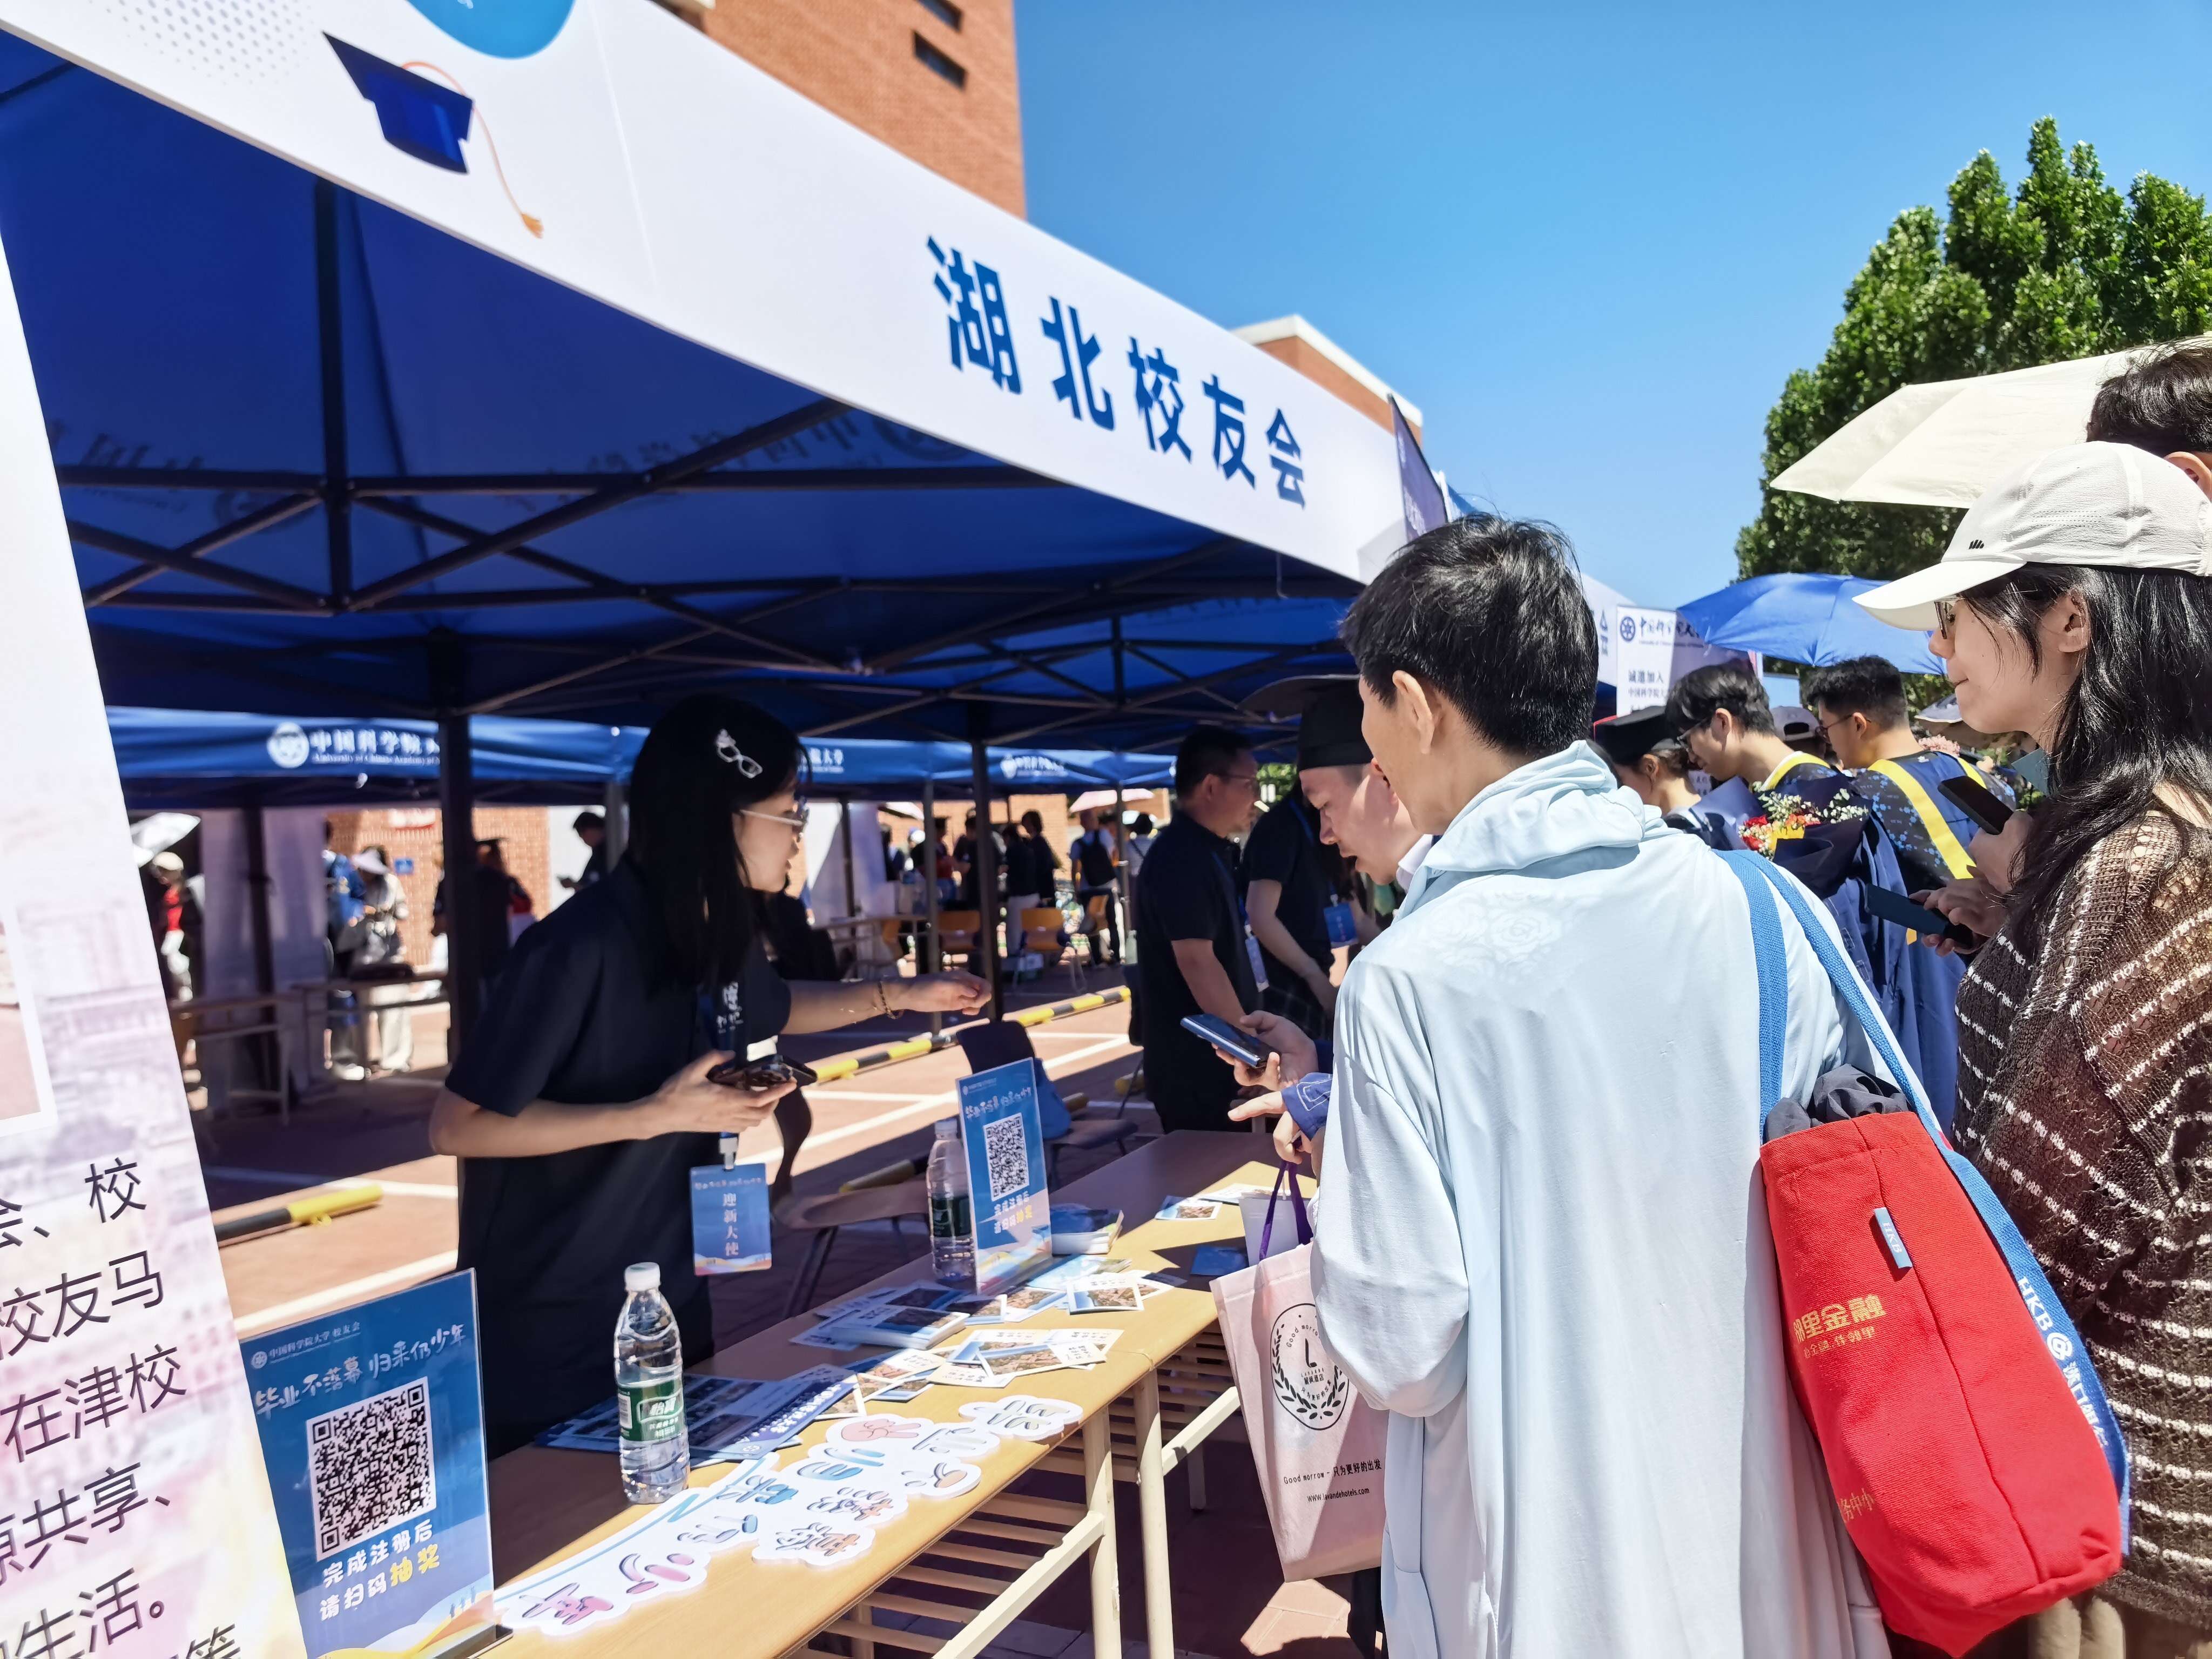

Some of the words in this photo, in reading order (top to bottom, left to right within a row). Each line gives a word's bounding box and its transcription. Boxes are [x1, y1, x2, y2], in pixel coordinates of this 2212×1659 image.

[927, 234, 1305, 509] 湖北校友会
[723, 1192, 739, 1257] 迎新大使
[1883, 1222, 1903, 1253] HKB
[0, 1250, 165, 1360] 校友马
[1286, 1326, 1299, 1348] Good
[1301, 1324, 1319, 1337] morro
[2018, 1276, 2053, 1331] HKB
[2, 1344, 187, 1462] 在津校
[254, 1355, 362, 1420] 毕业不落幕
[369, 1324, 467, 1379] 归来仍少年
[775, 1400, 1072, 1557] 毕业不落幕
[1284, 1475, 1301, 1485] Good
[1303, 1472, 1325, 1481] morrow
[1333, 1458, 1382, 1478] 只为更好的出发
[322, 1518, 433, 1589] 完成注册后
[519, 1447, 885, 1625] 归来仍少年
[0, 1567, 165, 1659] 生活。
[319, 1543, 441, 1621] 请扫码抽奖
